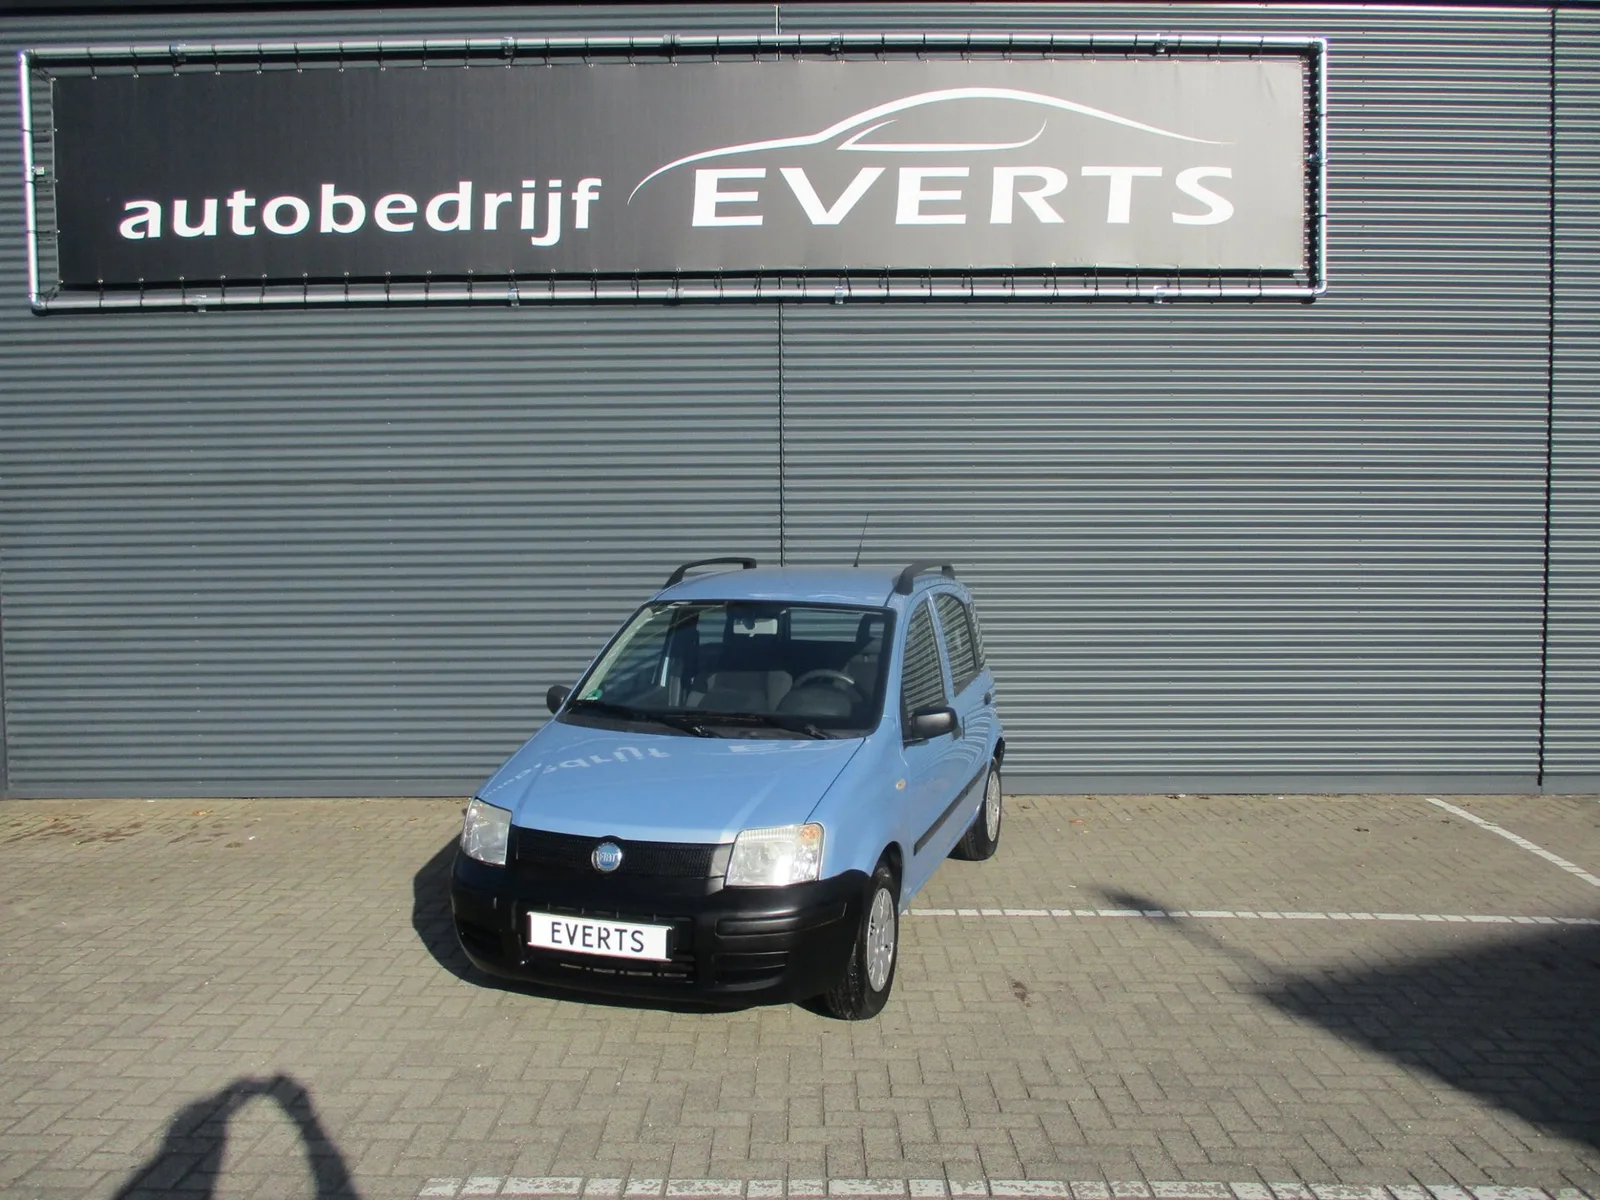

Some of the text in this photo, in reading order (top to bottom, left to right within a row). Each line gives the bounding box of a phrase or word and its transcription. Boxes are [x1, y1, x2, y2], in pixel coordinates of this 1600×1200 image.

[118, 165, 1236, 247] autobedrijf EVERTS
[550, 921, 645, 953] EVERTS
